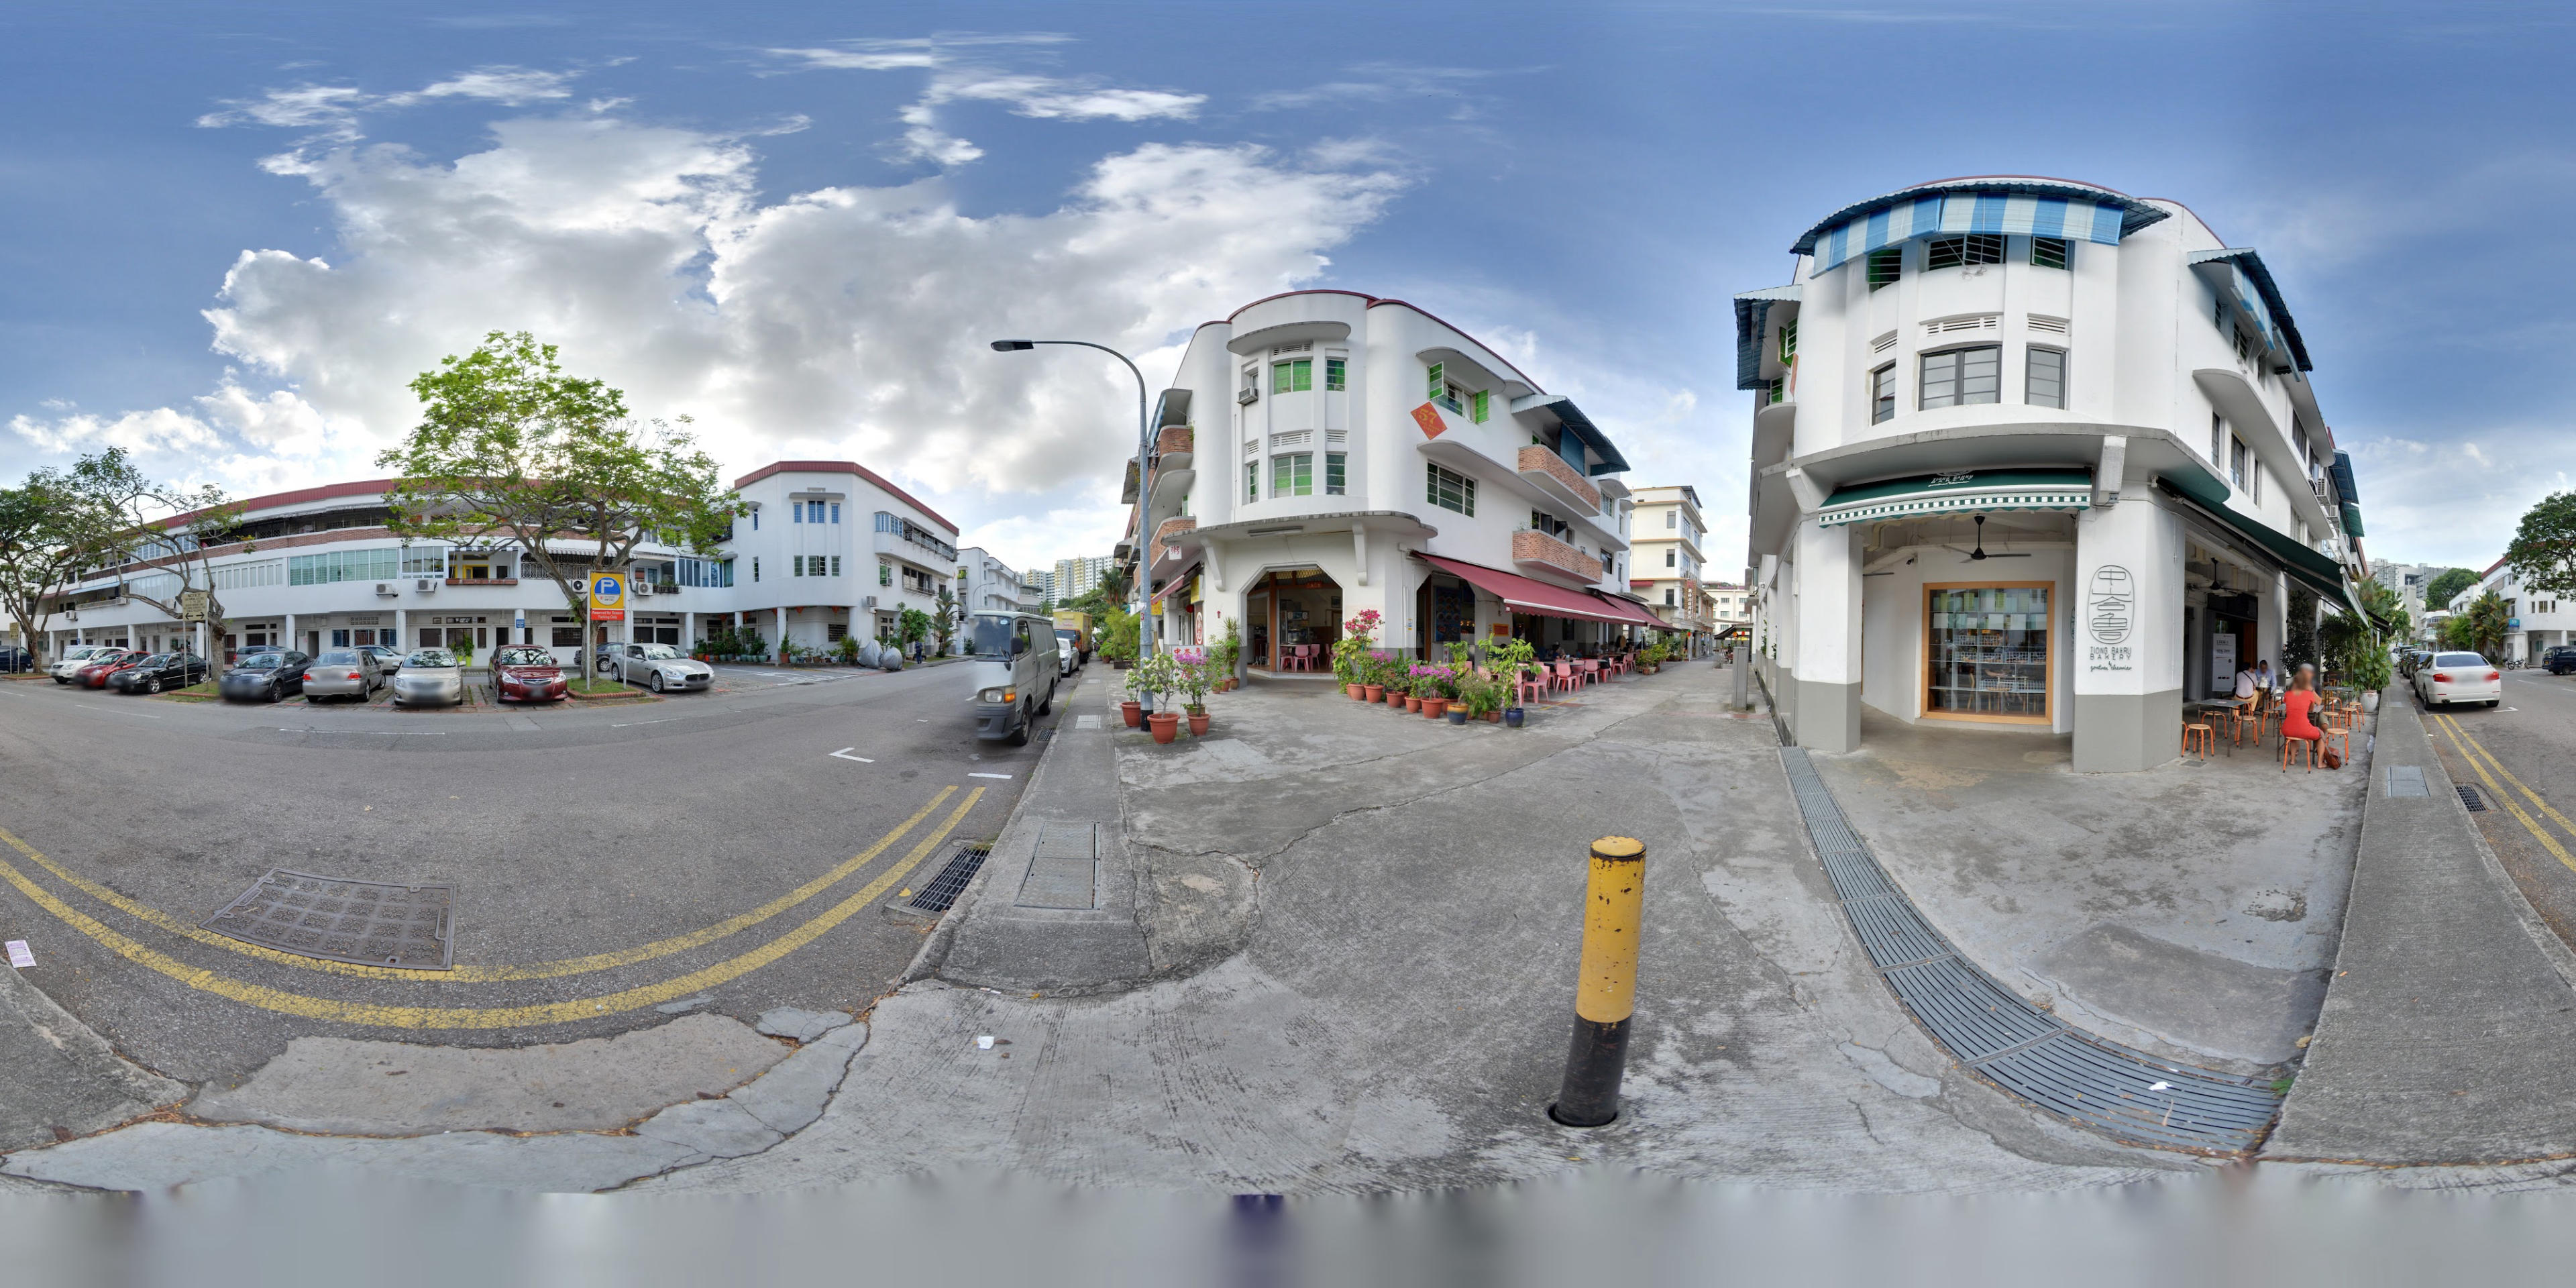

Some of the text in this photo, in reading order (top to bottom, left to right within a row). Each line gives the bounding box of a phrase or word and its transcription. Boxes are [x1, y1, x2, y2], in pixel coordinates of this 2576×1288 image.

[1418, 409, 1438, 425] 57
[600, 580, 614, 594] P
[2090, 646, 2132, 655] TIONG BAHRU
